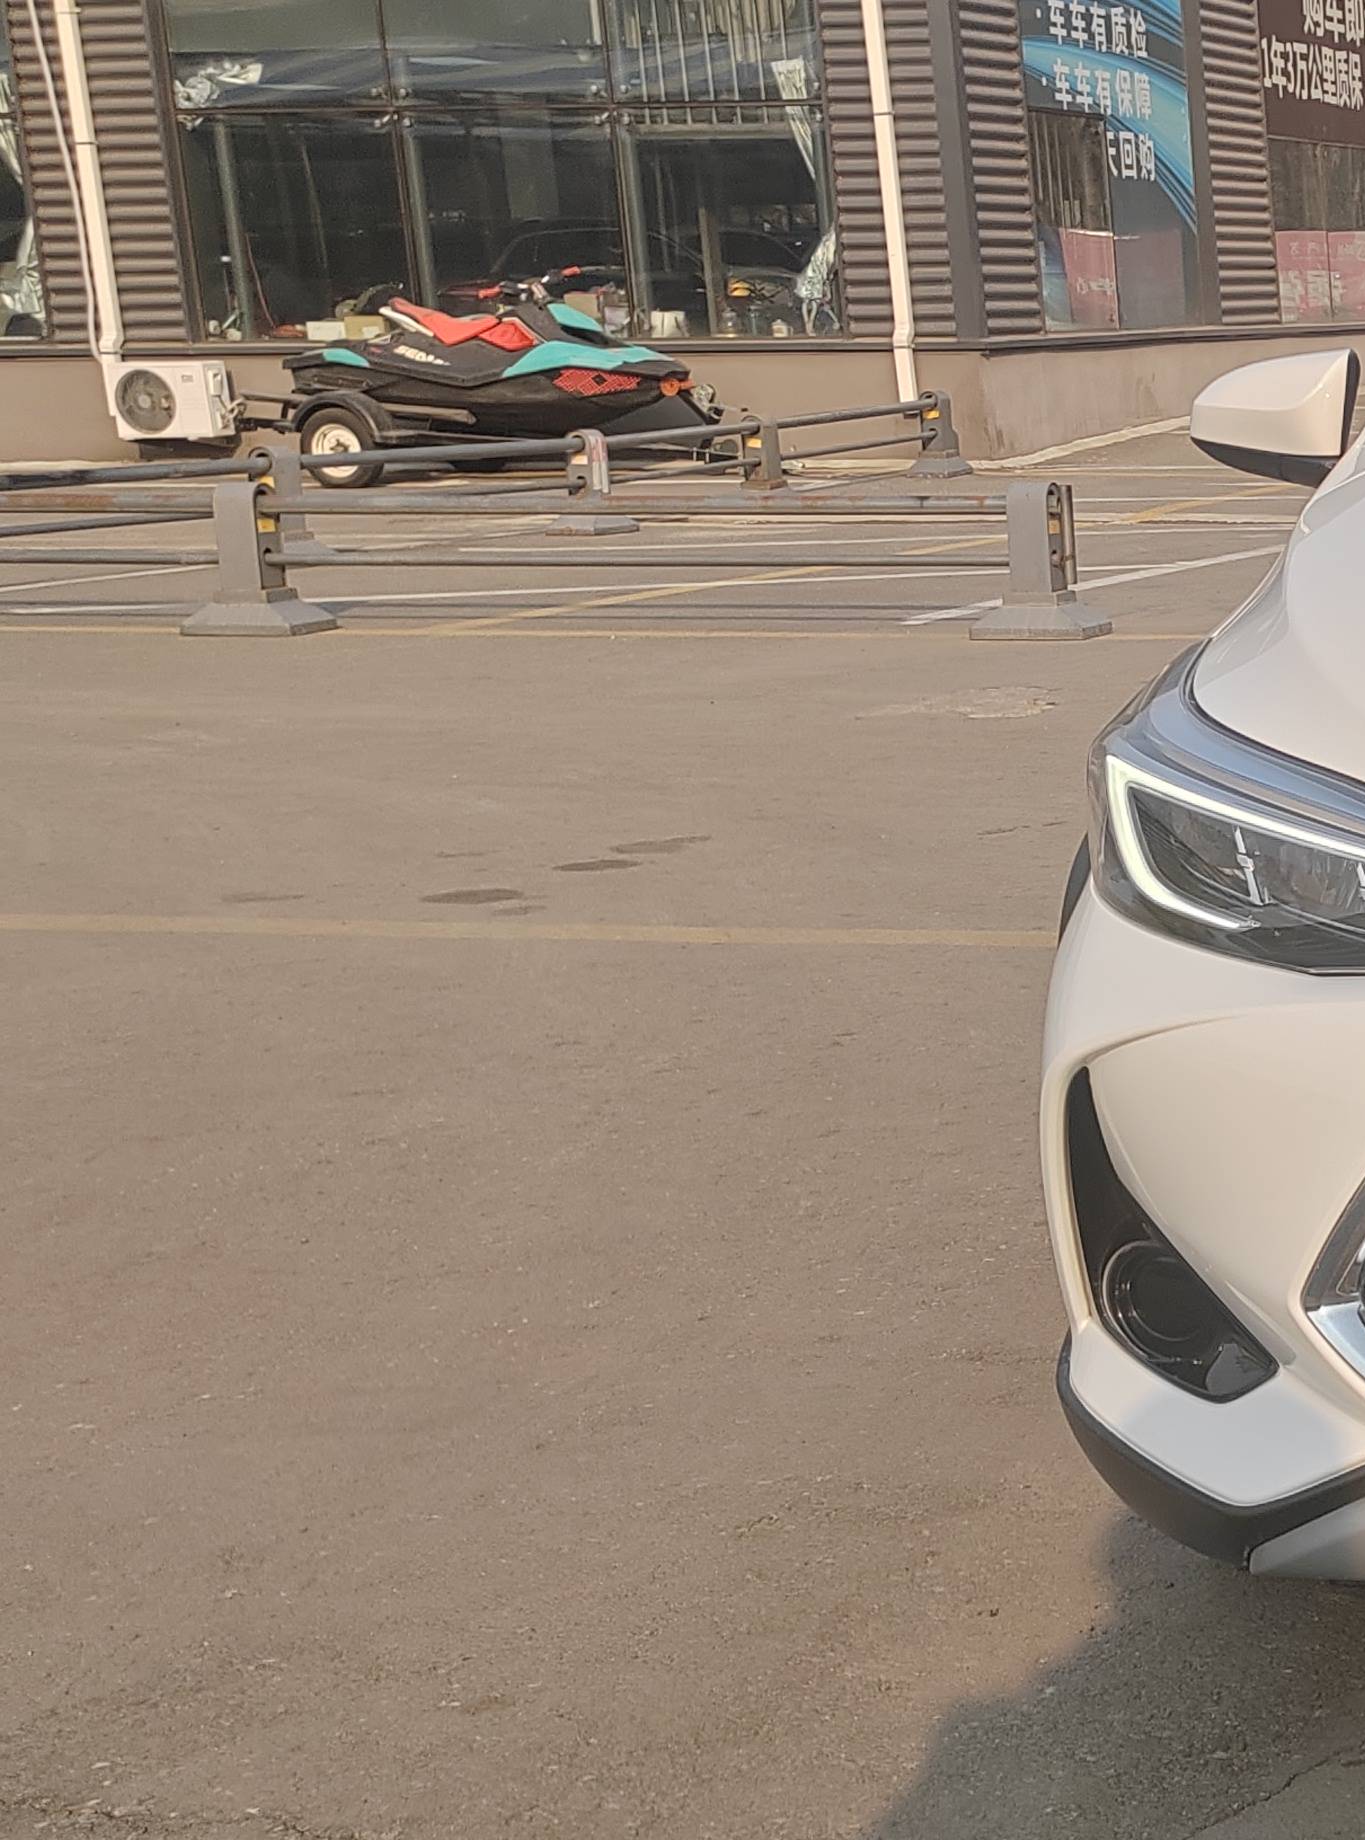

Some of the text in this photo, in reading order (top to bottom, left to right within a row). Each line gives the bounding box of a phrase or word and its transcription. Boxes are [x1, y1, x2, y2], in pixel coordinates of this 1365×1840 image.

[1052, 58, 1152, 120] 车车有保障
